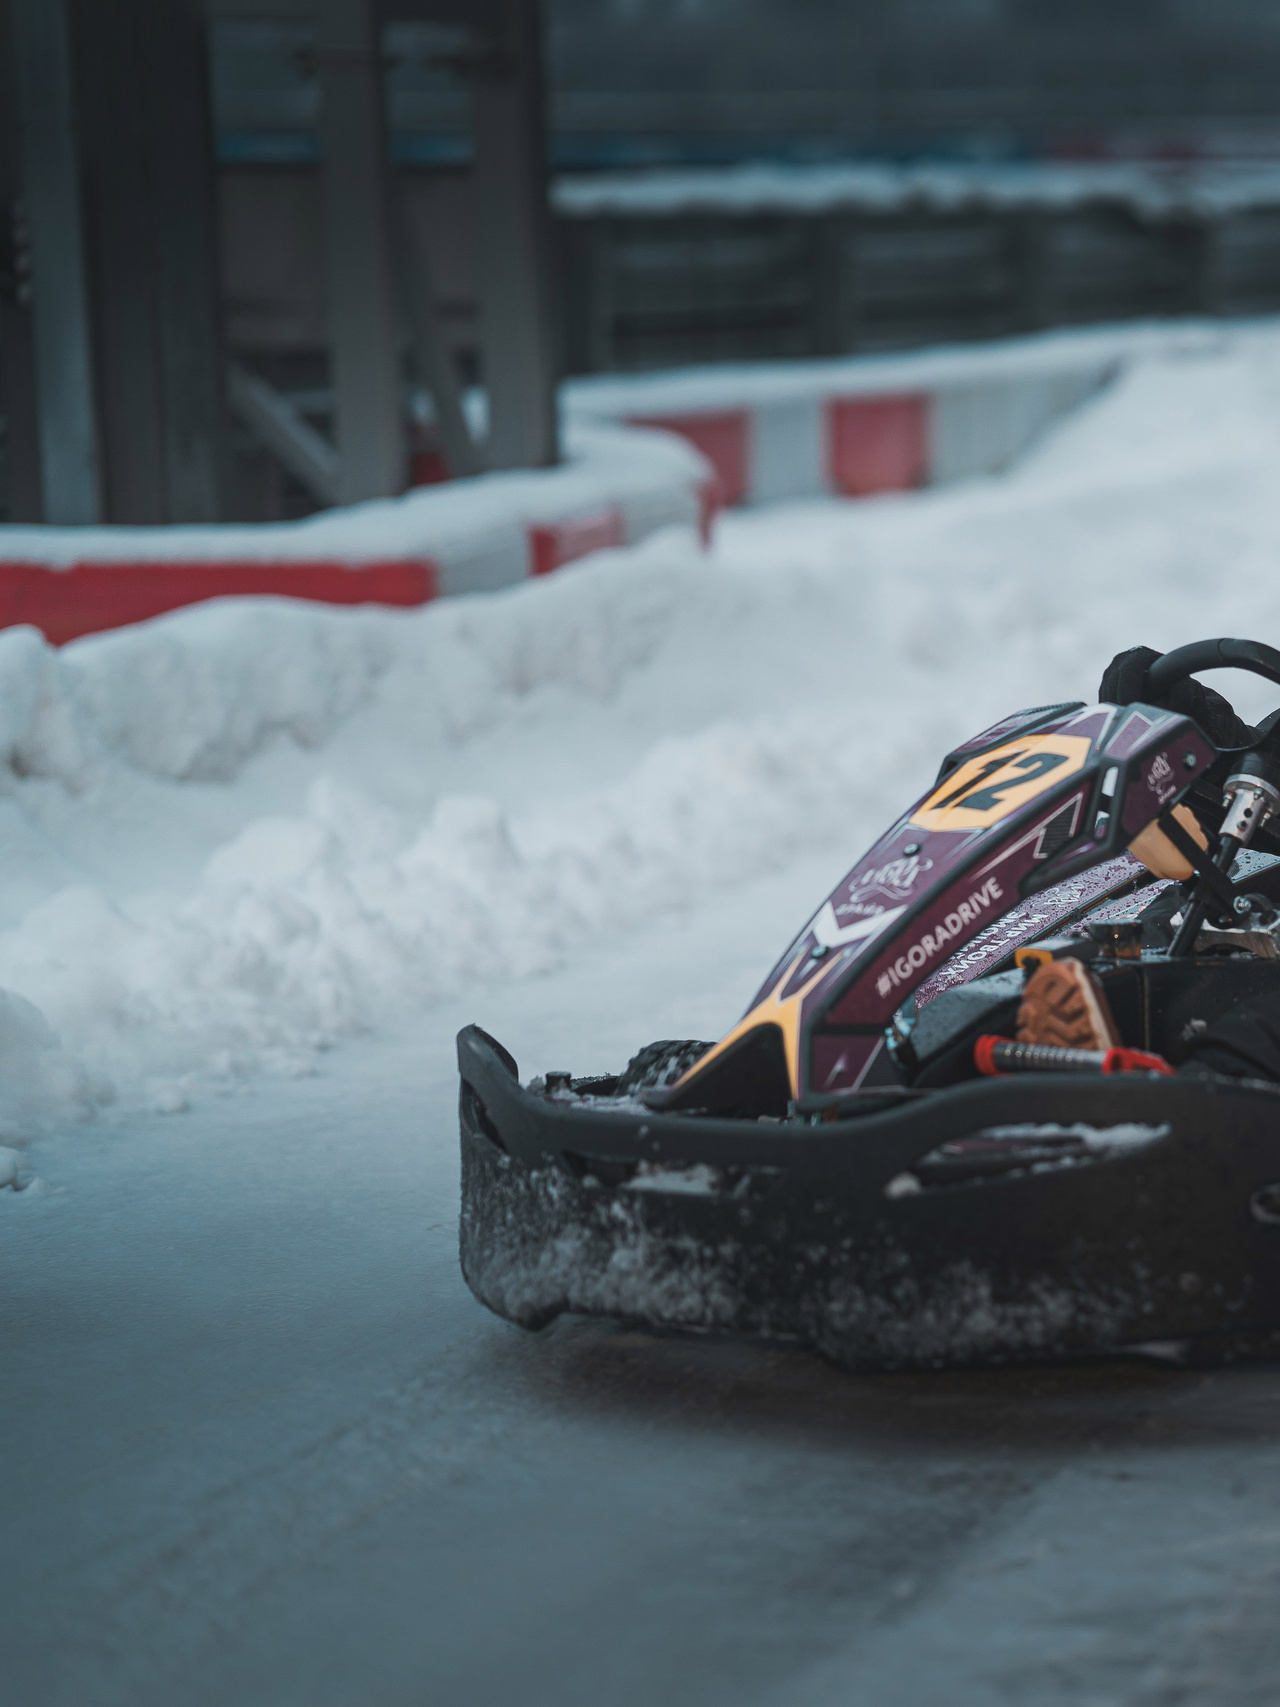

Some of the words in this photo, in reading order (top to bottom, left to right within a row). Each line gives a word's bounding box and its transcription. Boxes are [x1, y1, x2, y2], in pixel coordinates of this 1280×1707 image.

[930, 748, 1070, 811] 12
[875, 876, 1004, 998] #IGORADRIVE
[1006, 914, 1049, 938] МИР
